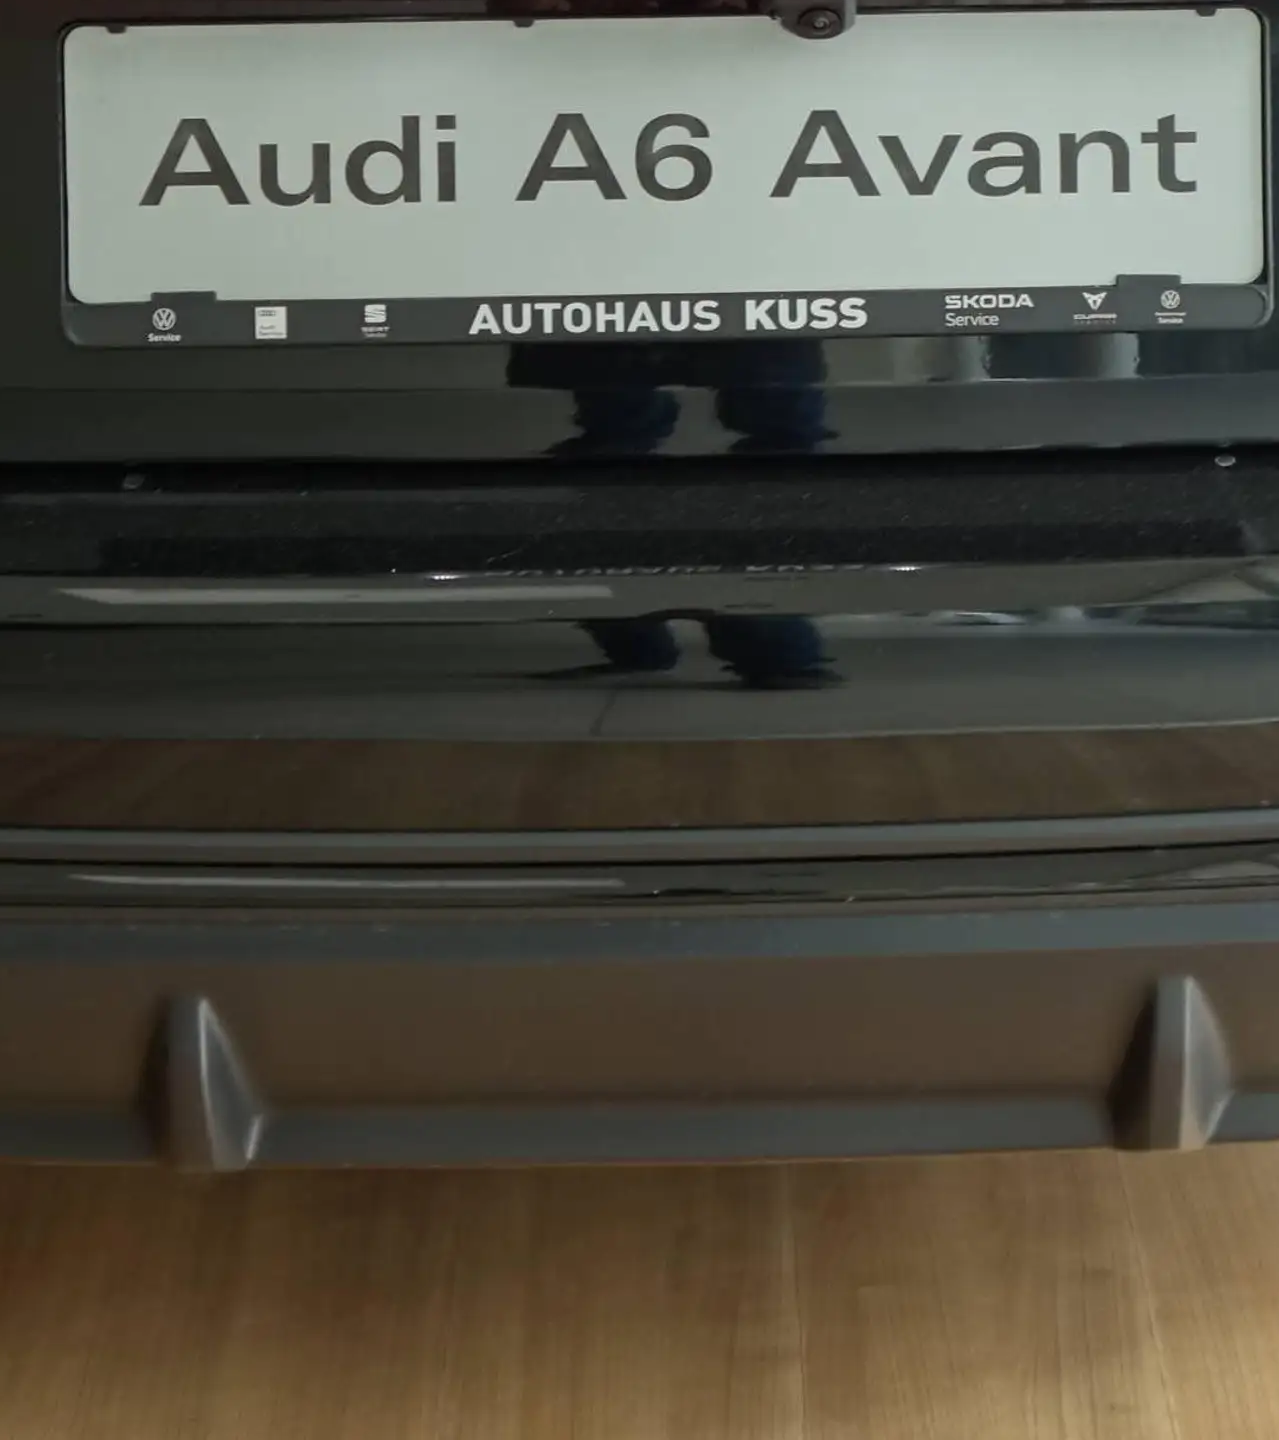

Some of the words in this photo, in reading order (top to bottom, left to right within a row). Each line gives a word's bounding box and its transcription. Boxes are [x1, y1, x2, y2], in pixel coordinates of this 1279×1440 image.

[138, 114, 457, 206] Audi
[515, 112, 713, 202] A6
[769, 109, 1198, 198] Avant
[468, 300, 720, 335] AUTOHAUS
[744, 297, 868, 331] KUSS
[944, 312, 1000, 327] Service
